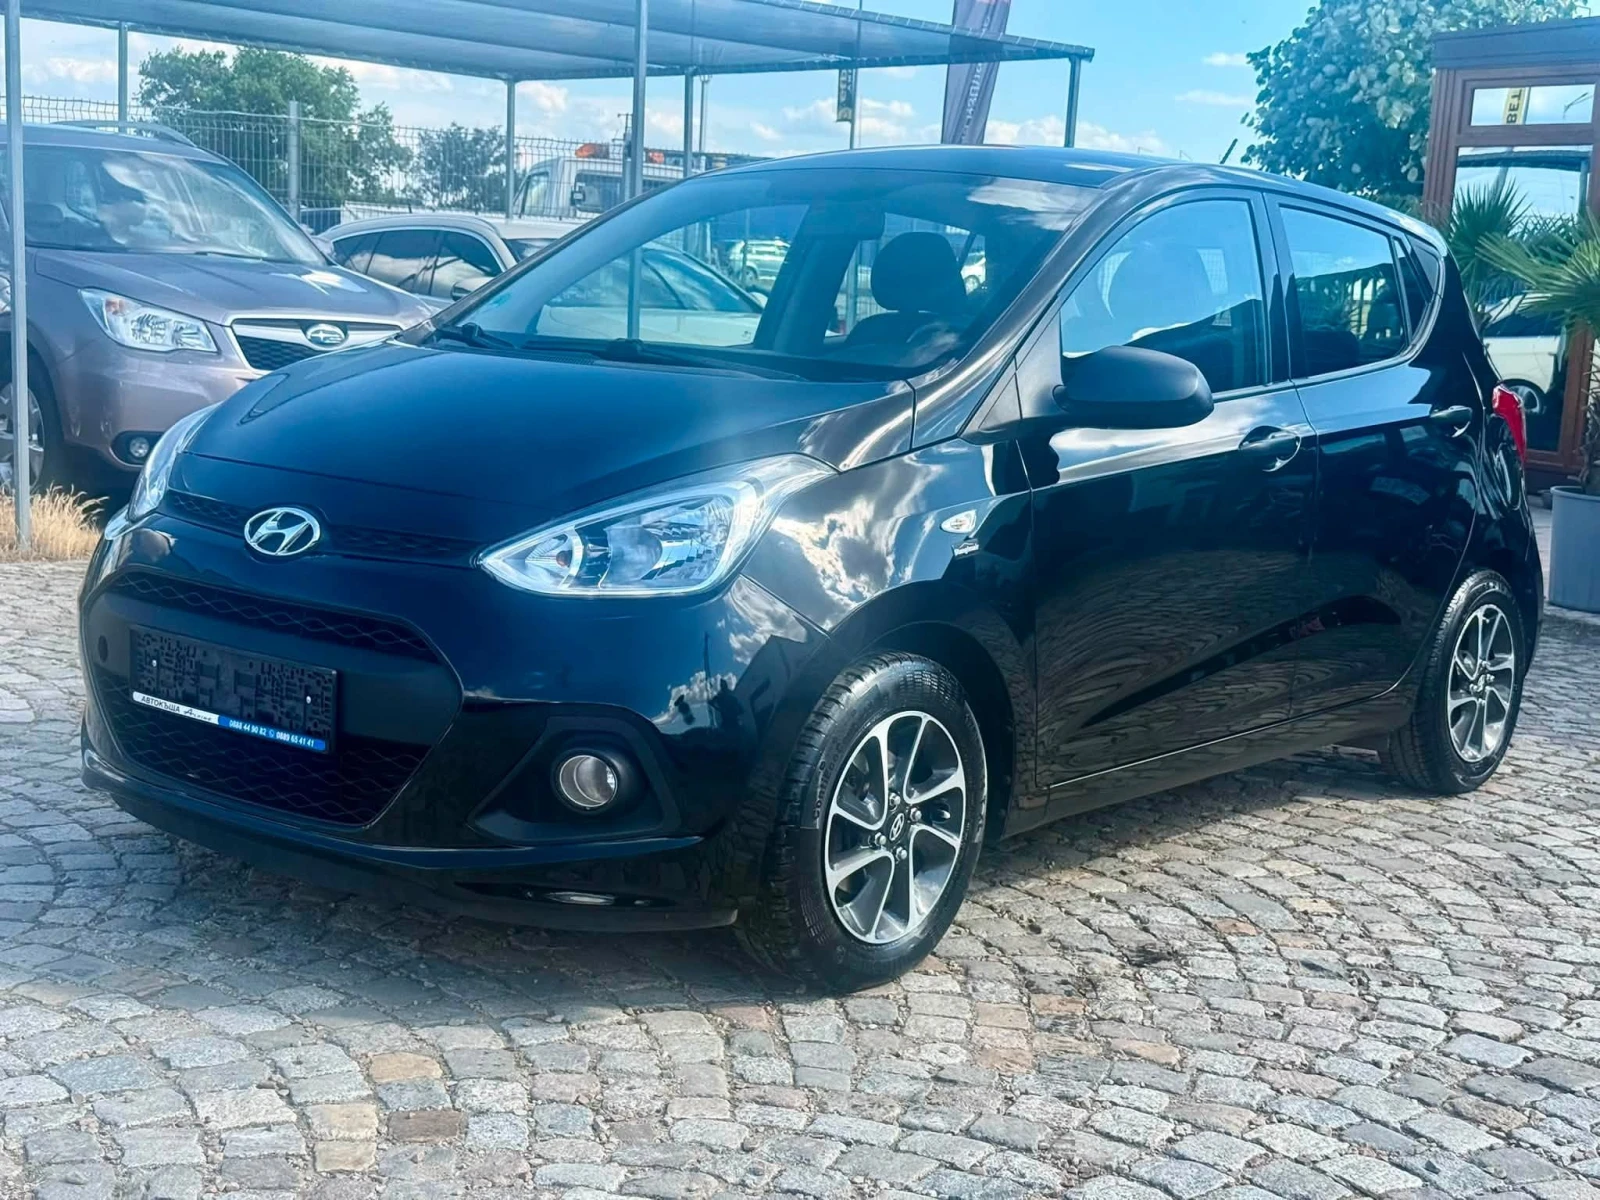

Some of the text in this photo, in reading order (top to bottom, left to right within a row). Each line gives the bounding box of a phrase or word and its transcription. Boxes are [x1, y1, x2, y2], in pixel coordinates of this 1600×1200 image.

[141, 695, 180, 712] АВТОКЪЩА
[229, 719, 242, 730] 0888
[243, 722, 251, 732] 44
[259, 726, 266, 736] 82
[290, 733, 298, 743] 65
[298, 735, 305, 745] 41
[306, 737, 314, 747] 41
